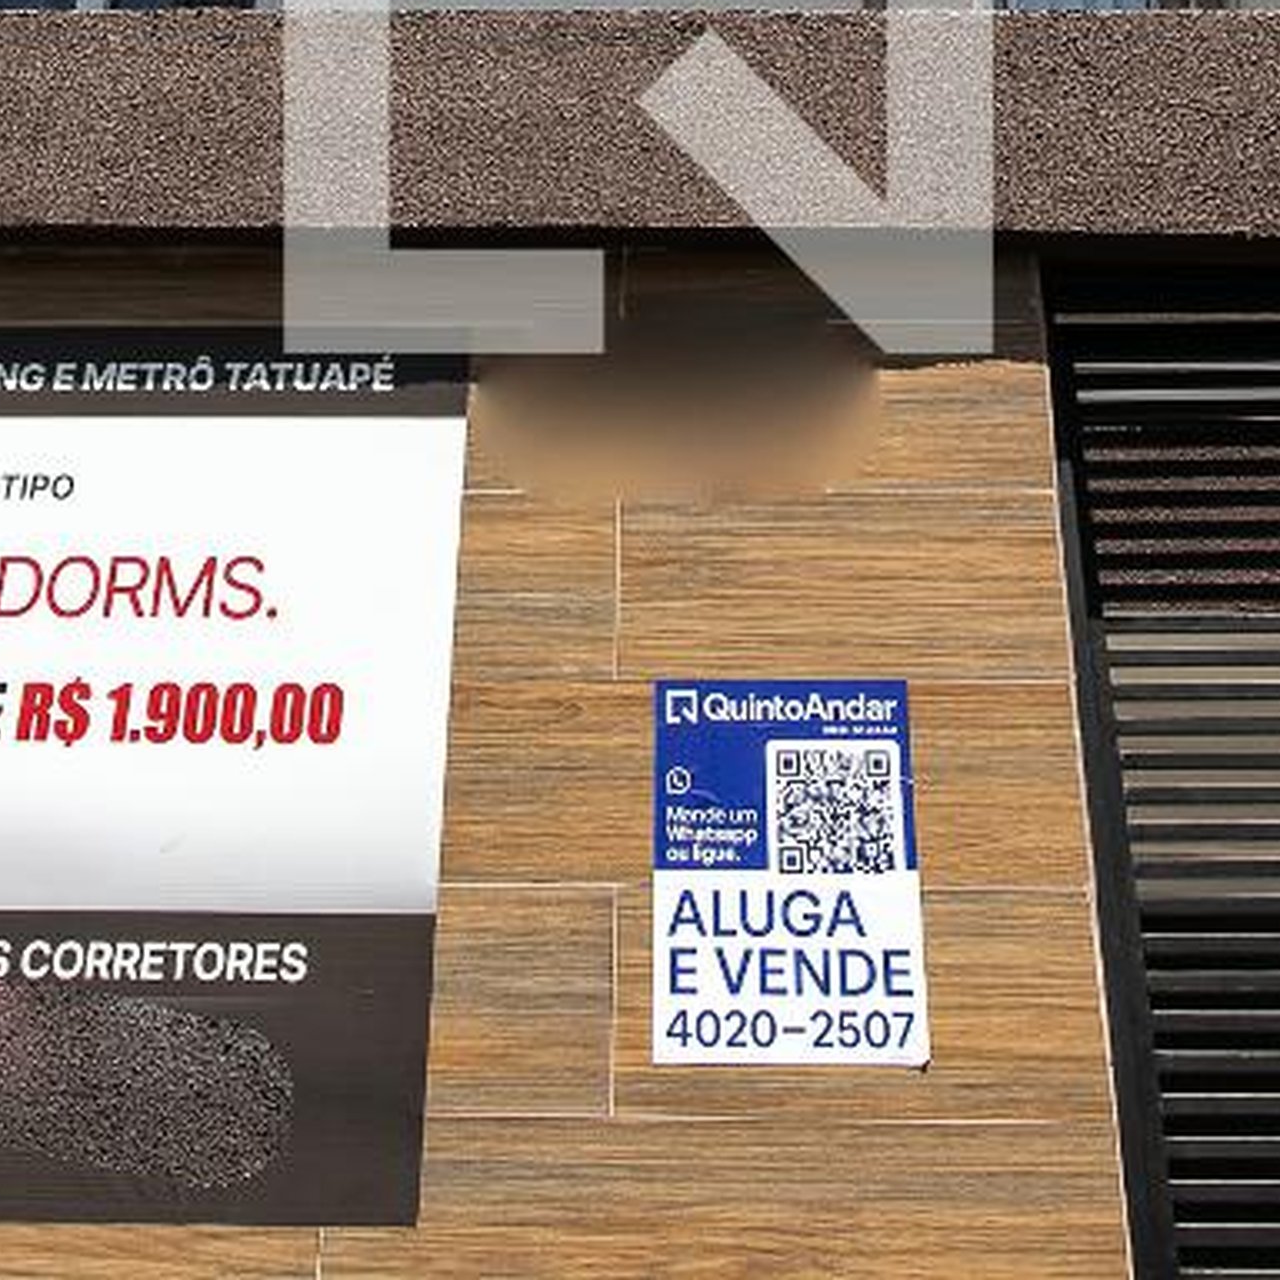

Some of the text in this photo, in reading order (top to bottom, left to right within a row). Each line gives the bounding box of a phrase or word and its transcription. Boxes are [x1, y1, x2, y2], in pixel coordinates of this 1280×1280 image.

[52, 362, 79, 392] E
[81, 355, 215, 393] METRÔ
[224, 354, 396, 392] TATUAPÉ
[1, 474, 76, 501] TIPO
[14, 676, 93, 747] R$
[106, 681, 345, 750] 1.900,00
[702, 693, 898, 721] QuintoAndar
[729, 809, 758, 823] um
[667, 889, 868, 938] ALUGA
[20, 939, 309, 983] CORRETORES
[669, 947, 915, 998] E VENDE
[665, 1008, 915, 1048] 4020-2507
